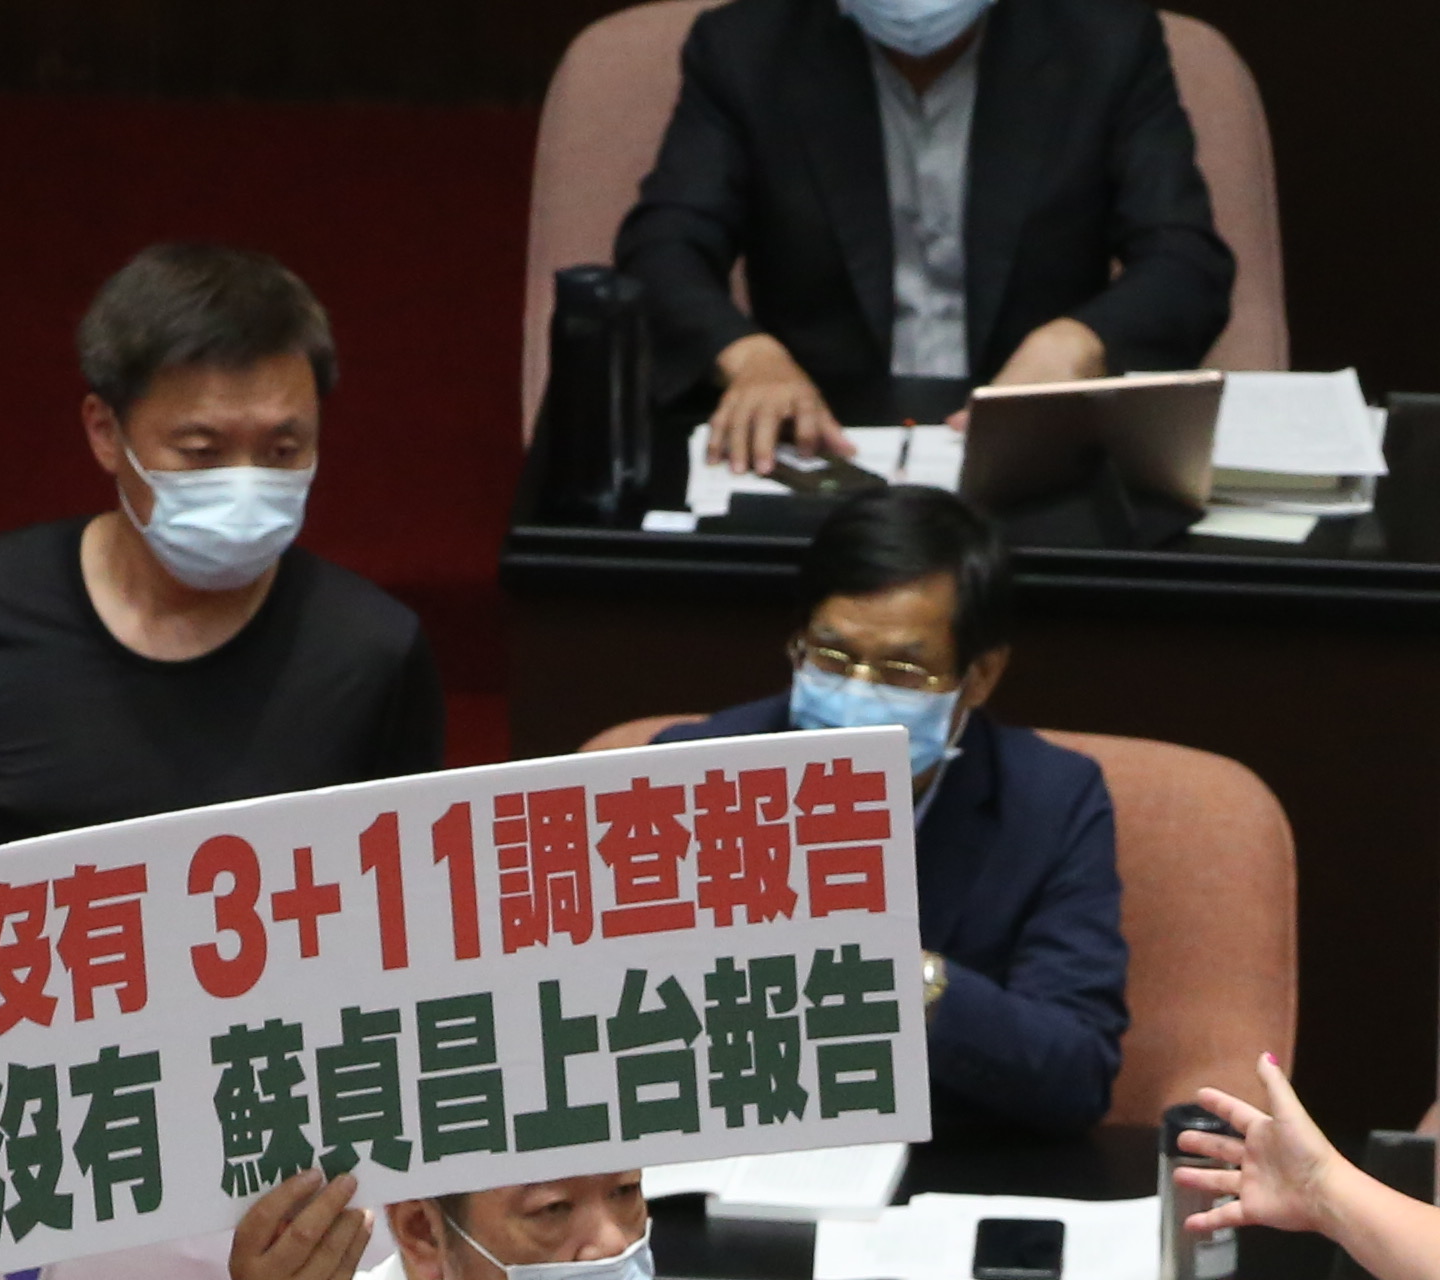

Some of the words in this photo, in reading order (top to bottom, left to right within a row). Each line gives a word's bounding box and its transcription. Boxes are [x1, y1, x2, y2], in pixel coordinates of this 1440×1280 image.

[184, 757, 892, 1000] 3+11調查報告
[210, 942, 901, 1200] 蘇貞昌上台報告
